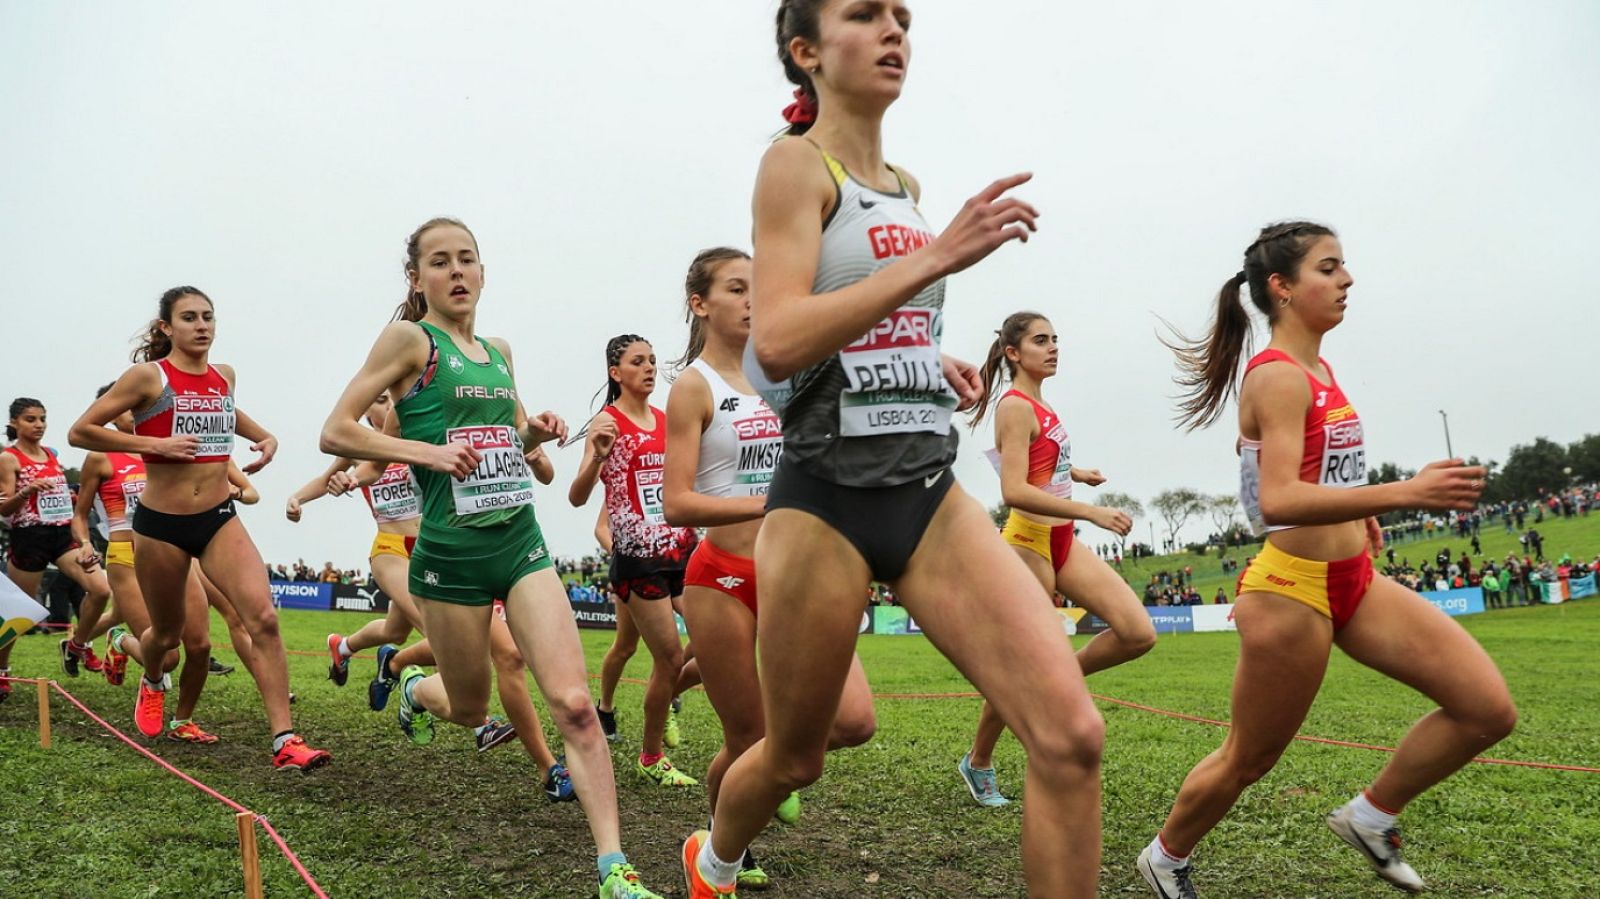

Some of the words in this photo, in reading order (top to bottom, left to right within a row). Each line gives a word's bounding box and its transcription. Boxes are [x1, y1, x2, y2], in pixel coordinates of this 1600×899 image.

[177, 398, 222, 411] SPAR
[738, 418, 781, 438] SPA
[475, 494, 514, 509] LISBOA
[1265, 574, 1296, 588] ESP
